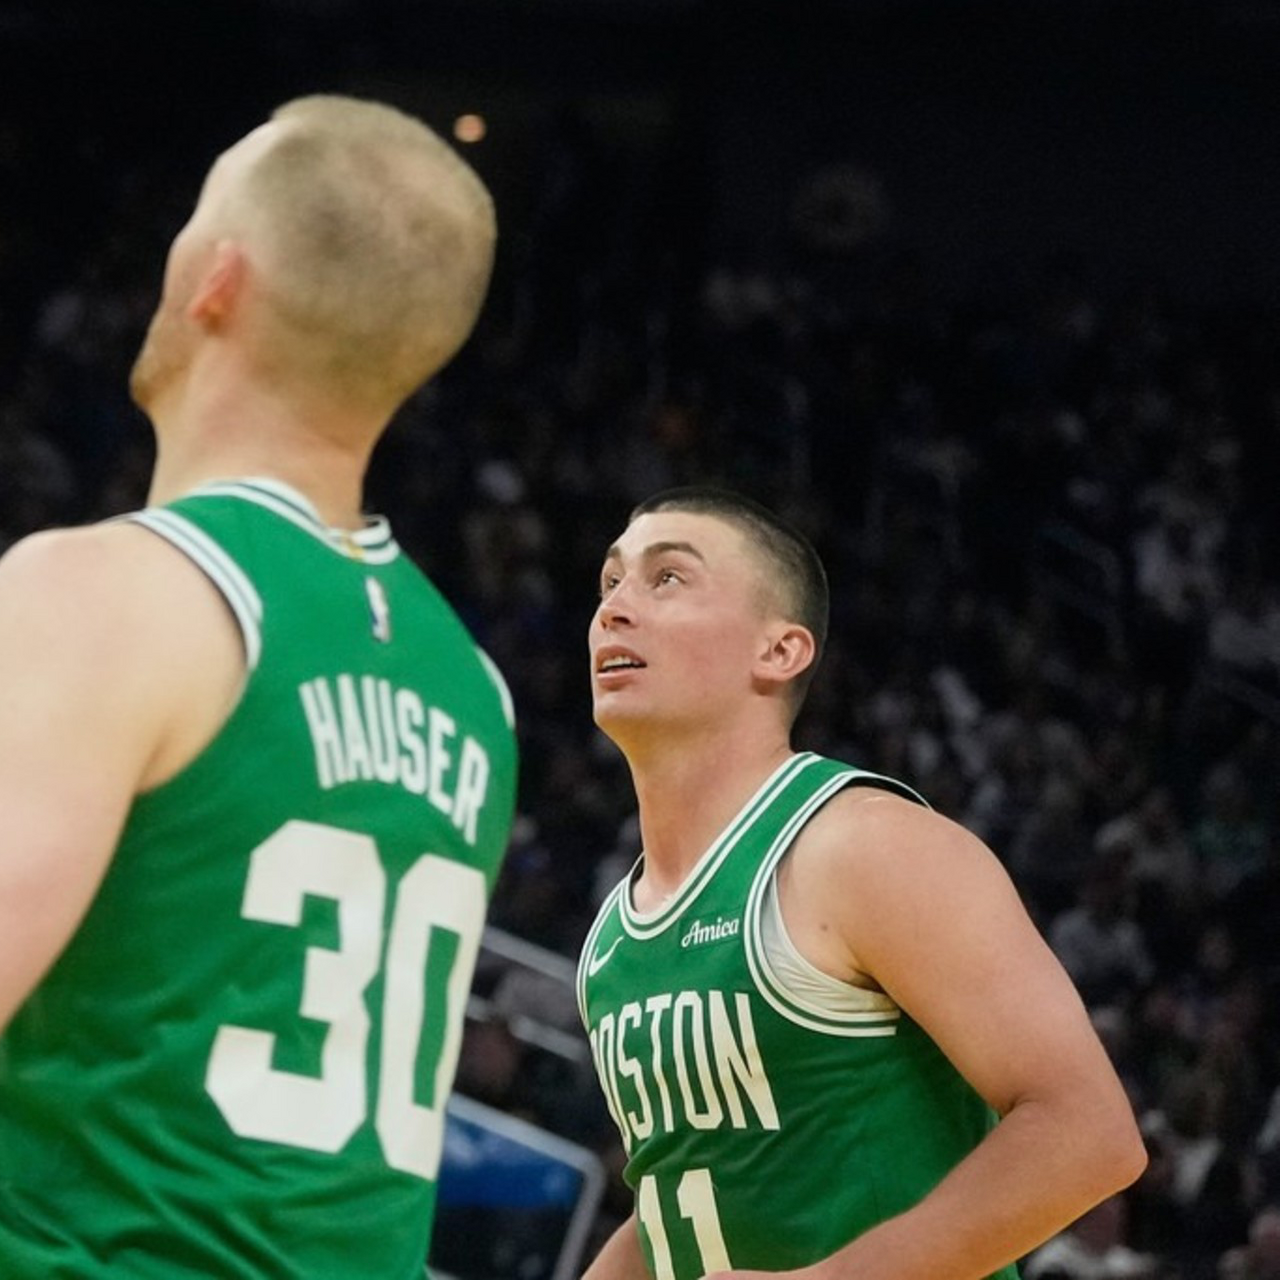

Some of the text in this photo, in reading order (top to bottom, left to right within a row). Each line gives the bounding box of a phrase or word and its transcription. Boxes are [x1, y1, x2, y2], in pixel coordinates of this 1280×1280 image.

[299, 674, 488, 845] HAUSER
[205, 819, 486, 1180] 30
[681, 917, 740, 947] Amica
[639, 1168, 732, 1280] 11
